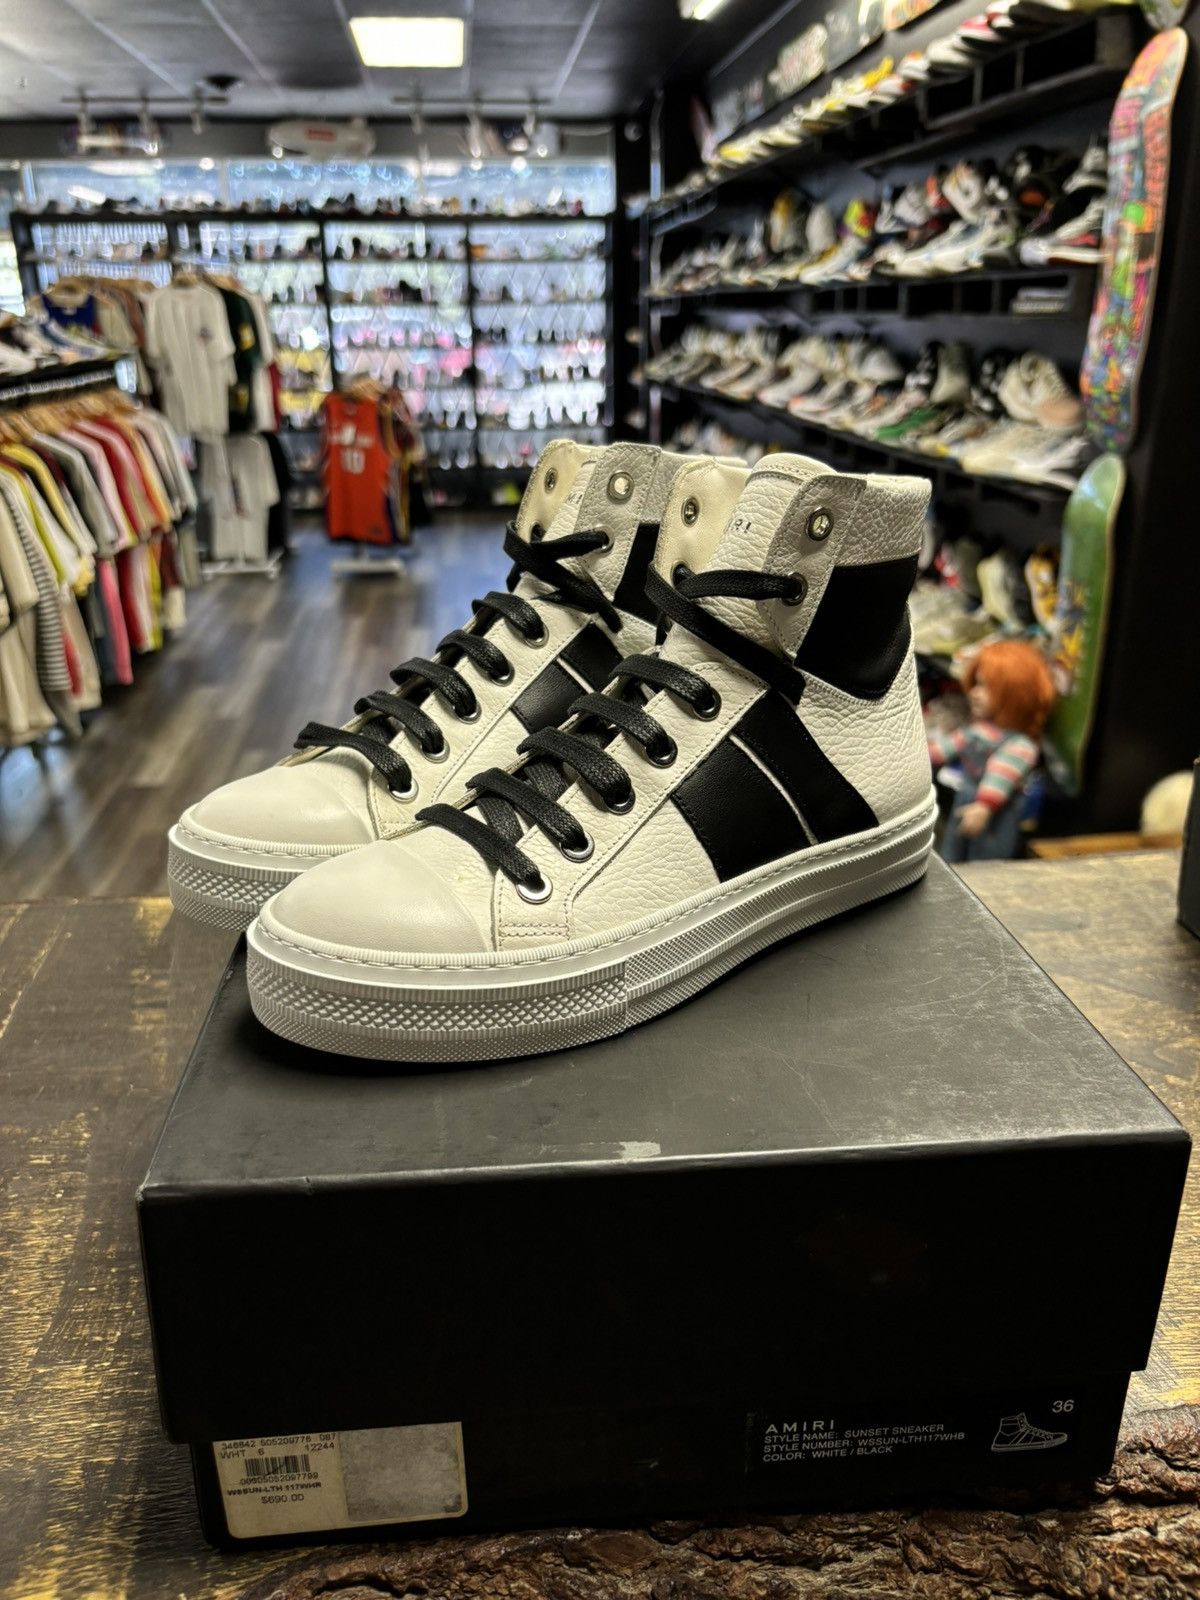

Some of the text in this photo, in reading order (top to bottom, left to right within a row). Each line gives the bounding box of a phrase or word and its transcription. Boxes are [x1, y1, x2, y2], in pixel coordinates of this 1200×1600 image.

[1051, 1399, 1075, 1414] 36
[764, 1424, 944, 1444] STYLE NAME: SUNSET SNEAKER
[765, 1419, 835, 1434] AMIRI
[220, 1449, 246, 1459] WHT
[258, 1448, 265, 1456] 6
[763, 1443, 799, 1453] STYLE
[802, 1439, 853, 1450] NUMBER:
[763, 1451, 806, 1462] COLOR:
[812, 1448, 847, 1459] WHITE
[857, 1446, 894, 1455] BLACK
[261, 1493, 305, 1504] $690.00
